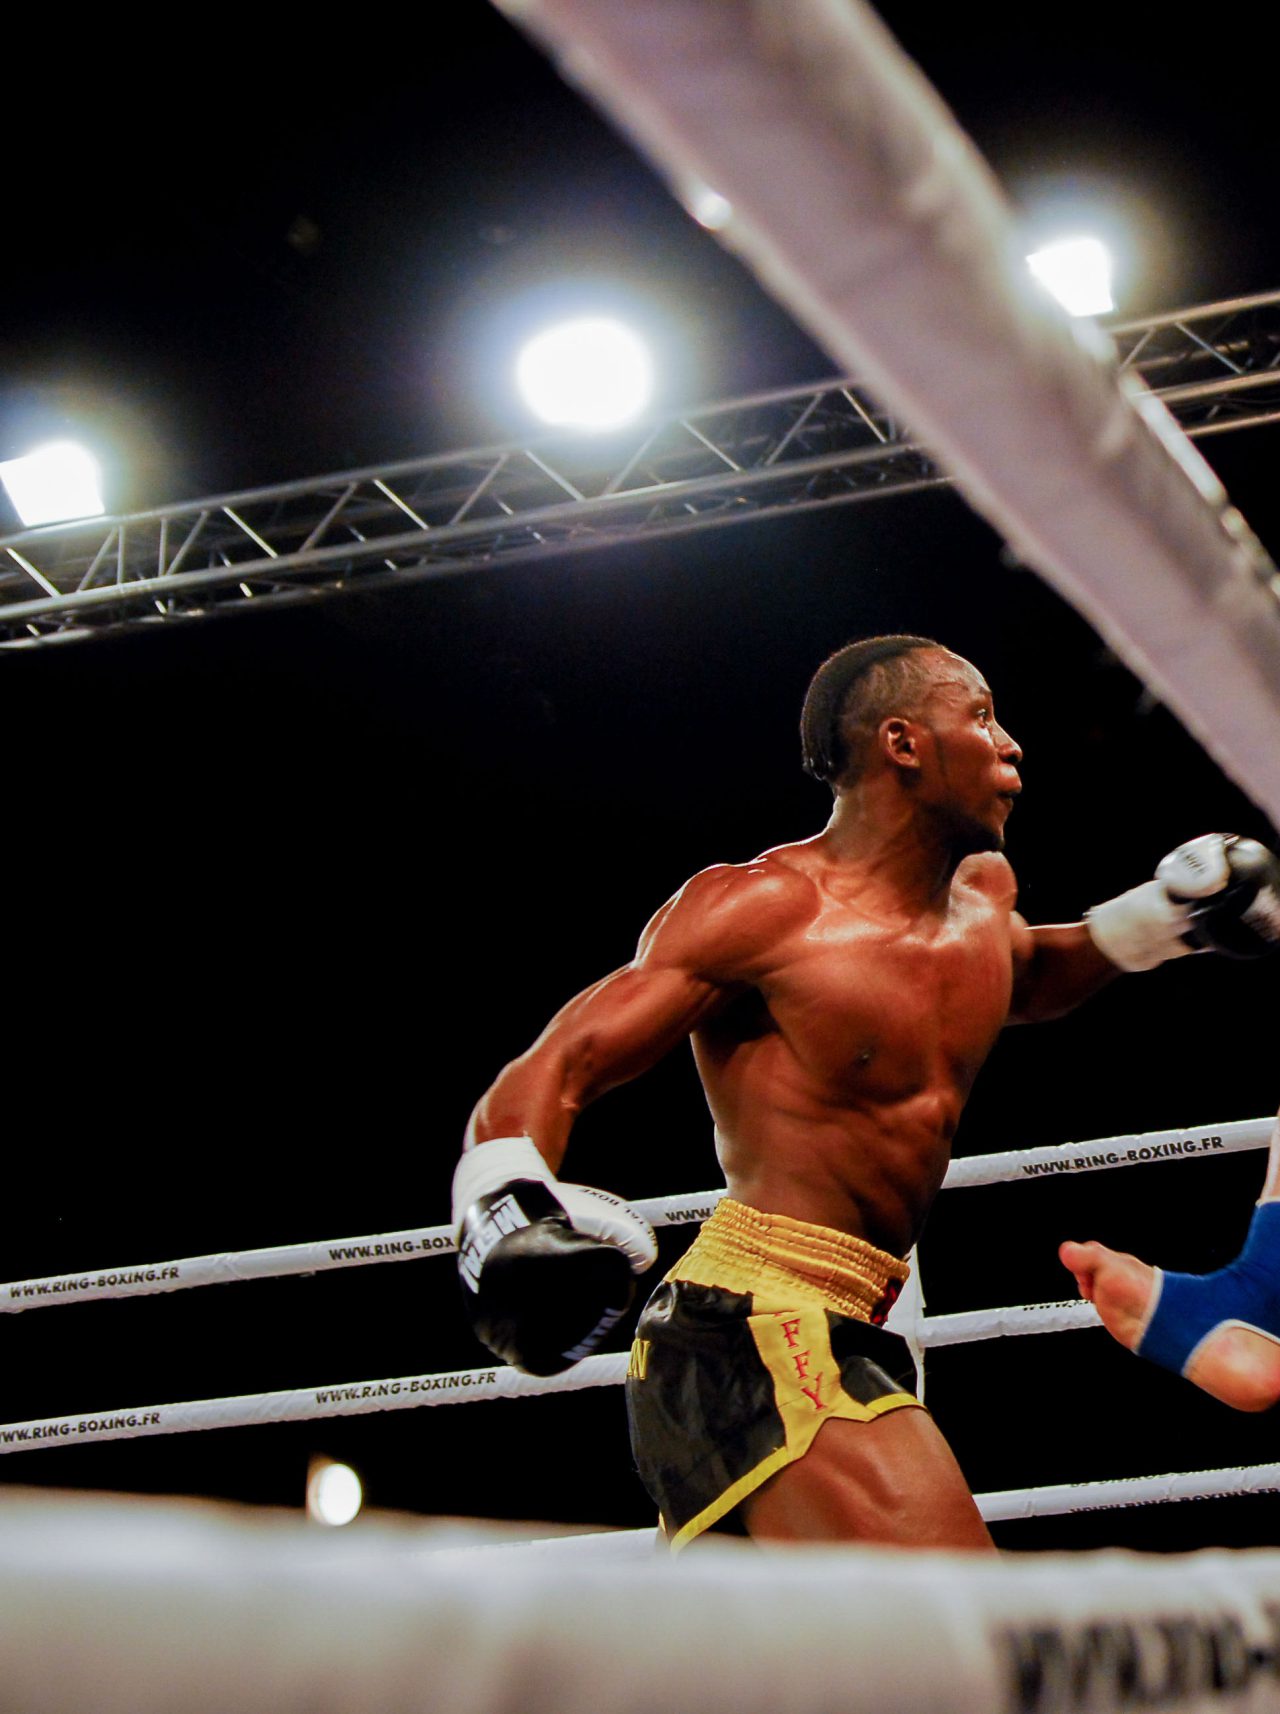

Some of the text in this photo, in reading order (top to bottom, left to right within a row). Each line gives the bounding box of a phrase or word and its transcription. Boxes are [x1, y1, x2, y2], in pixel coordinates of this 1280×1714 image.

[1023, 1136, 1224, 1175] WWW.RING-BOXING.FR
[10, 1267, 179, 1298] WWW.RING-BOXING.FR
[0, 1412, 161, 1444] WW.RING-BOXING.FR
